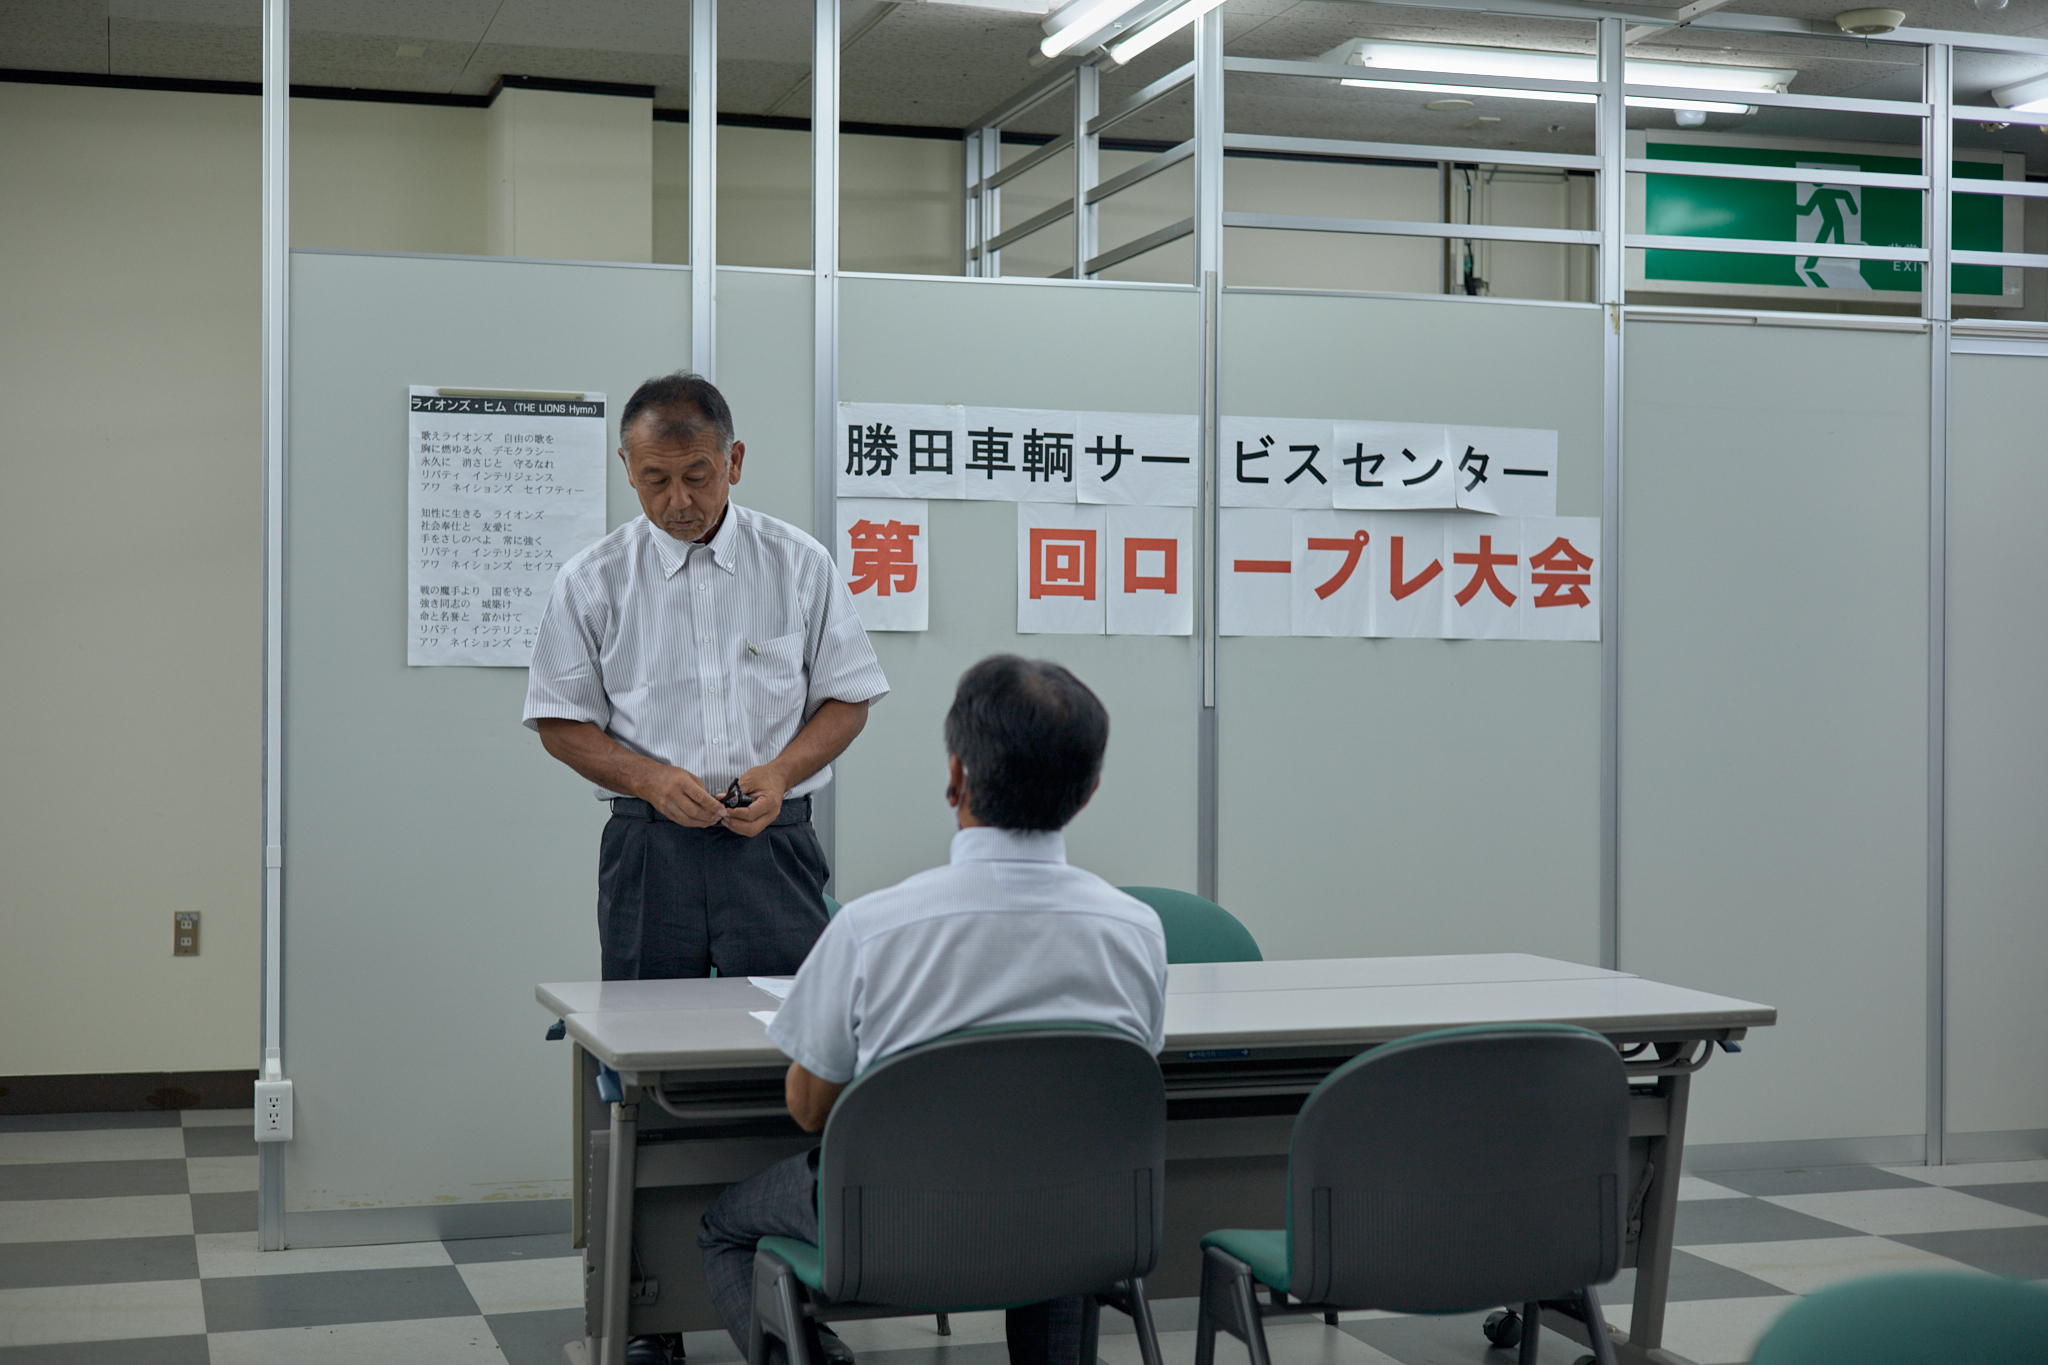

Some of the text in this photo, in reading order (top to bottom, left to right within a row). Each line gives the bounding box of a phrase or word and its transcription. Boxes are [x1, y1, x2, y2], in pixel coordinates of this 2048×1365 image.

[412, 399, 506, 412] ライオンズ・ヒム
[539, 405, 566, 413] LIONS
[421, 430, 554, 444] 歌えライオンズ 自由の歌を
[421, 444, 554, 456] 胸に燃ゆる火 デモクラシー
[421, 457, 554, 469] 永久に 消さじと 守るなれ
[421, 470, 554, 482] リバティ インテリジェンス
[421, 483, 584, 496] アワ ネイションズ セイフティー
[421, 507, 544, 520] 知性に生きる ライオンズ
[421, 520, 512, 532] 社会奉仕と 友愛に
[421, 534, 542, 546] 手をさしのべよ 常に強く
[421, 547, 554, 558] リバティ インテリジェンス
[847, 518, 920, 597] 第
[420, 560, 439, 569] アワ
[451, 560, 512, 571] ネイションズ
[420, 585, 533, 597] 戦の魔手より 国を守る
[420, 598, 512, 609] 強き同志の 城築け
[420, 611, 522, 623] 命と名誉と 富かけて
[421, 625, 458, 634] リバティ
[420, 638, 439, 647] アワ
[450, 638, 511, 648] ネイションズ
